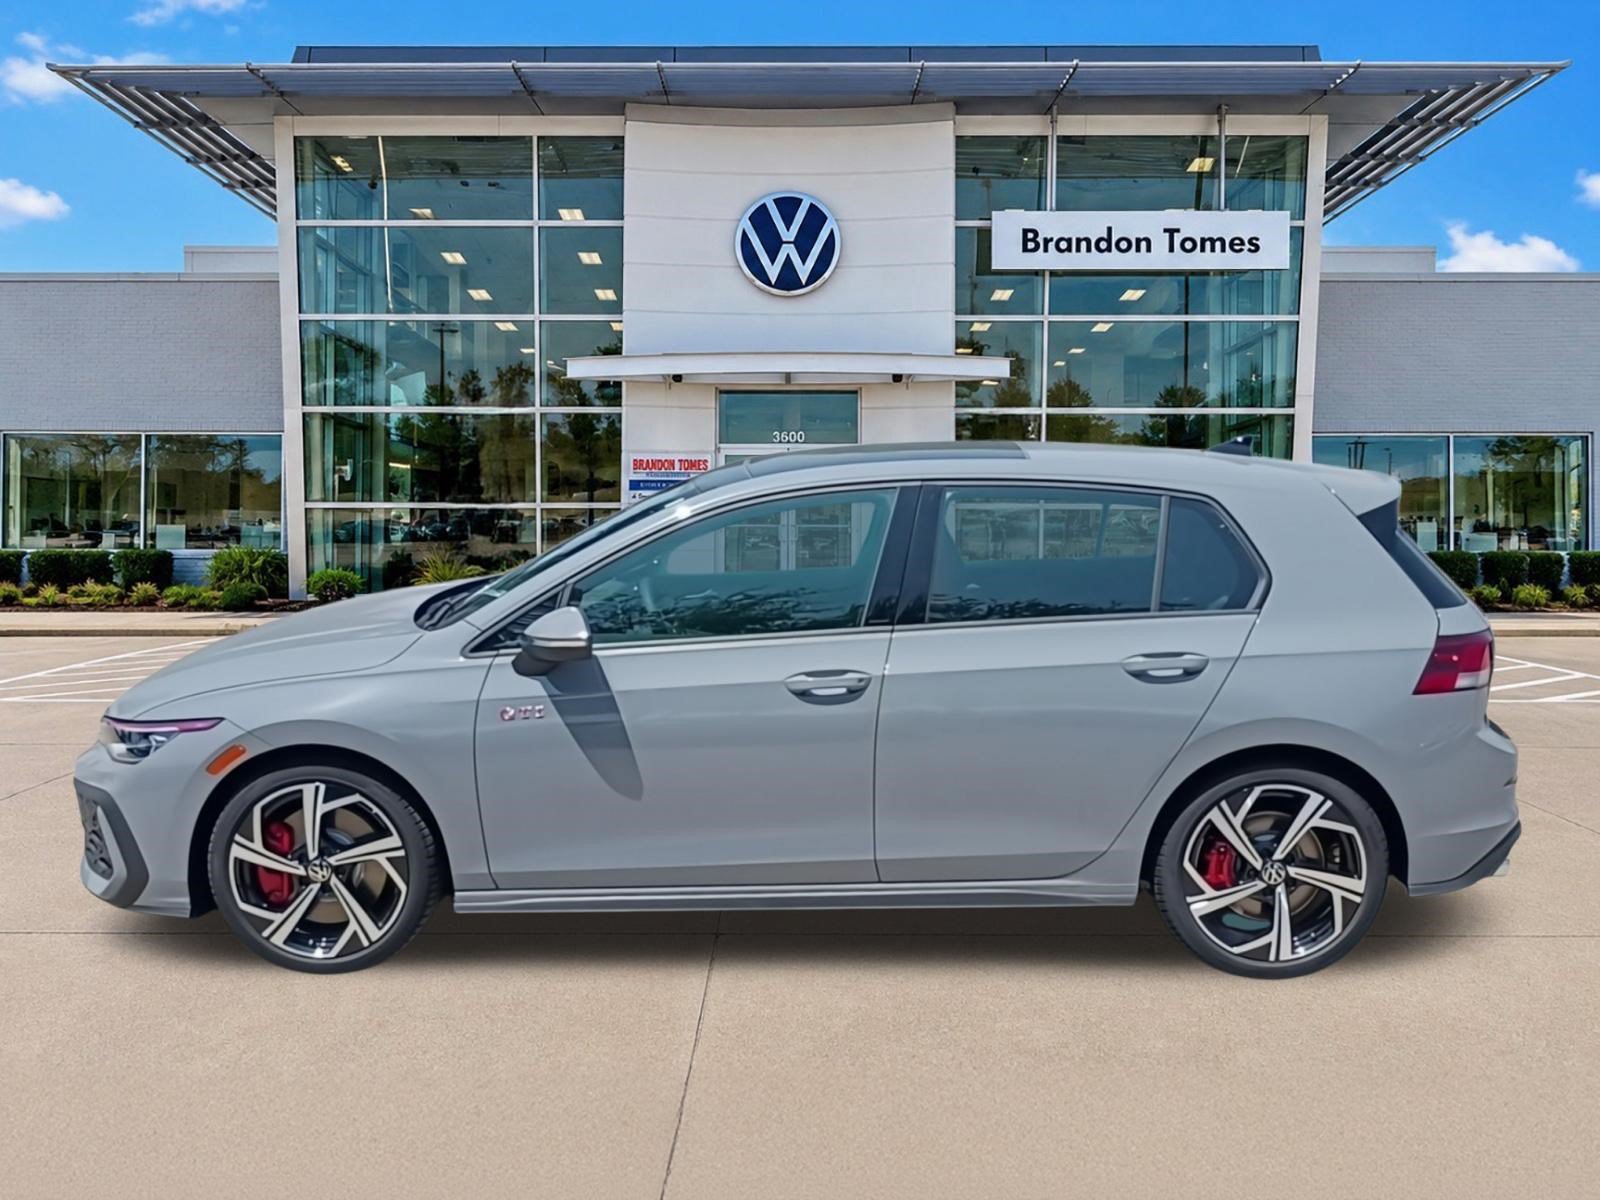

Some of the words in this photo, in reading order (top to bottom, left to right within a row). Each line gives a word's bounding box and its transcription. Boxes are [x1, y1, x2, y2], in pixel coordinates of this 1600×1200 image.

[735, 191, 841, 296] VW
[1021, 226, 1152, 253] Brandon
[1163, 227, 1261, 253] Tomes
[772, 431, 805, 443] 3600
[632, 459, 675, 470] BRANDON
[678, 459, 709, 470] TOMES
